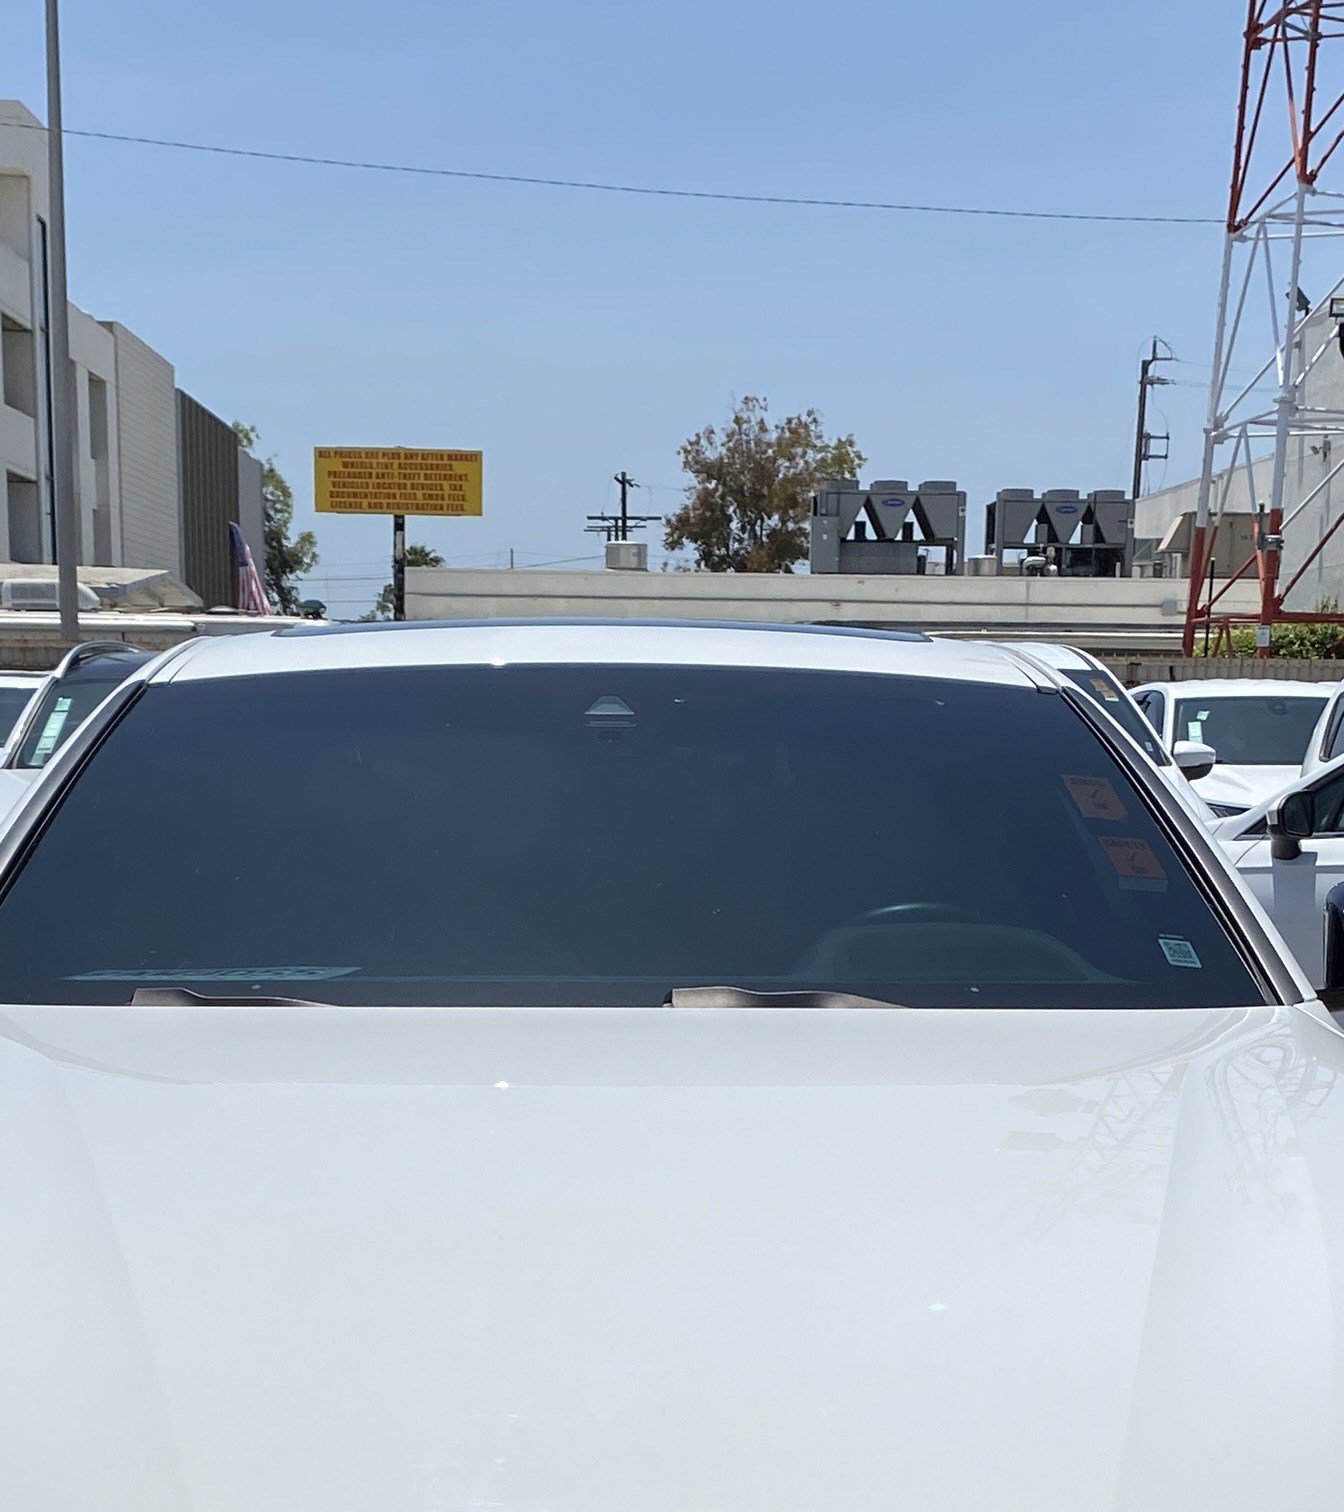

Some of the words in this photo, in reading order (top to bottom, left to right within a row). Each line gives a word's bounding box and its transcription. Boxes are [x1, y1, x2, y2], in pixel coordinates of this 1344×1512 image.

[382, 451, 401, 460] PLUS
[404, 452, 419, 460] ANY
[329, 490, 397, 500] DOCUMENTATION
[367, 501, 384, 510] AND
[386, 502, 444, 511] REGISTRATION
